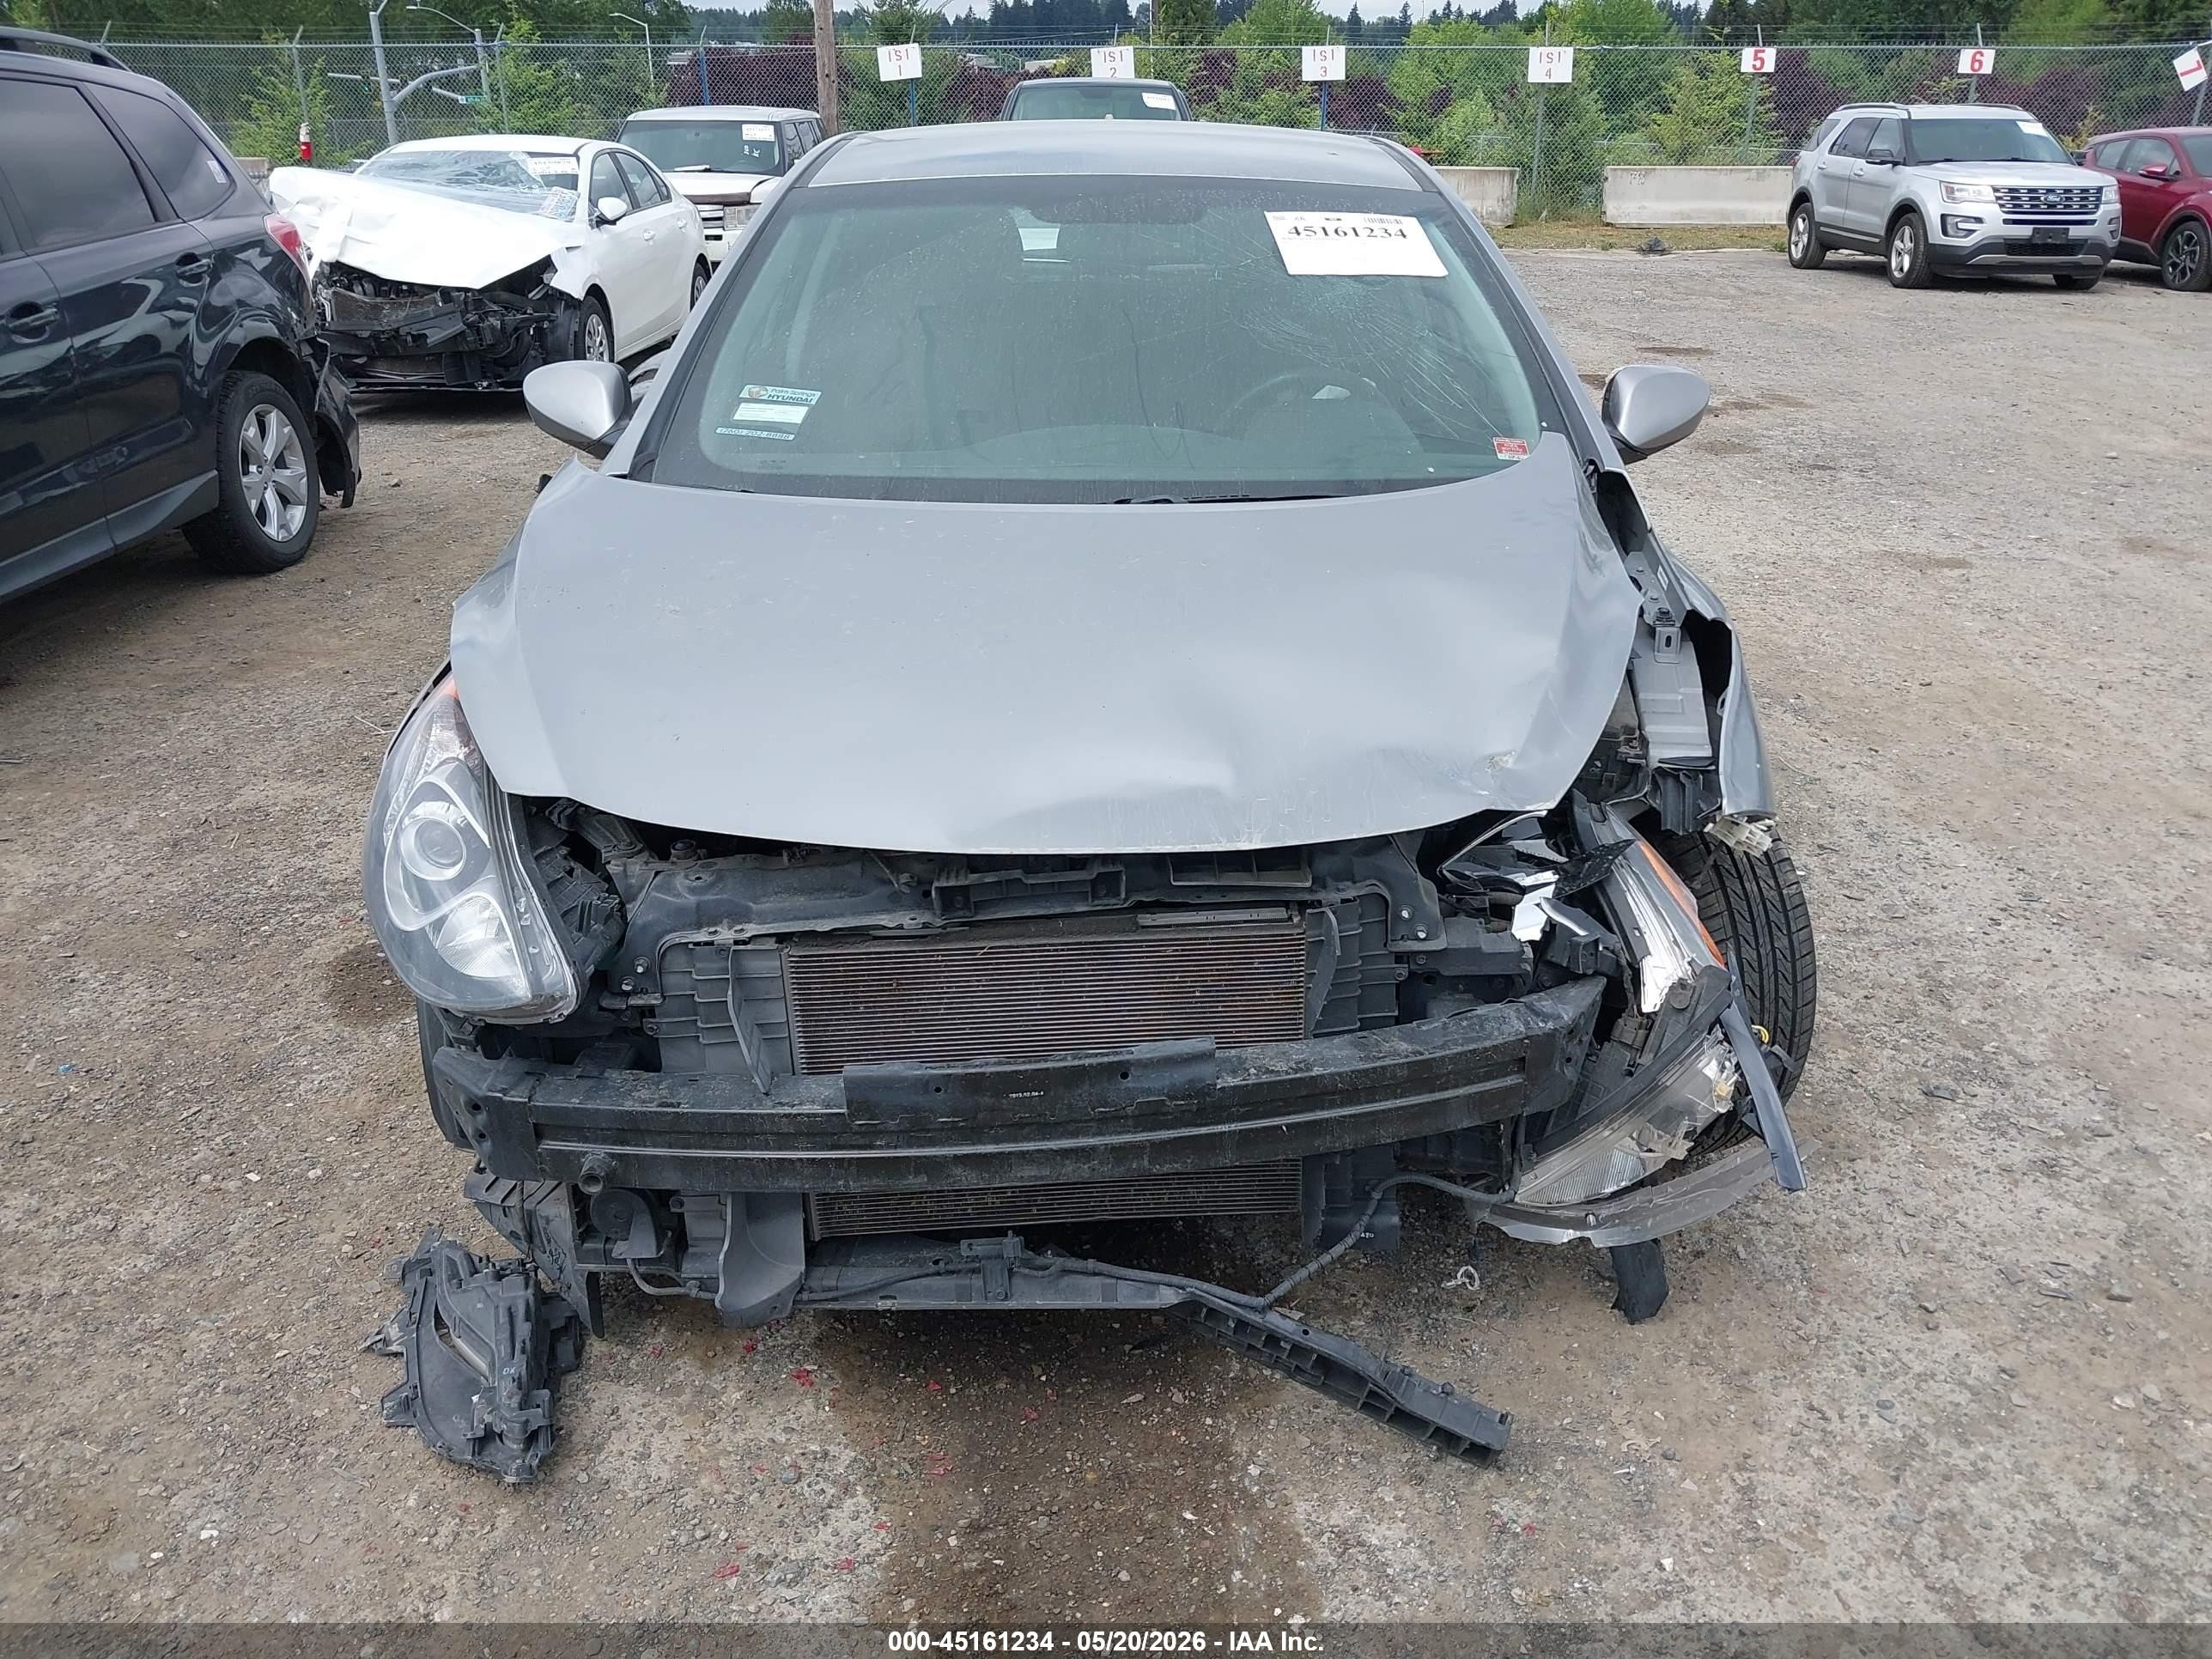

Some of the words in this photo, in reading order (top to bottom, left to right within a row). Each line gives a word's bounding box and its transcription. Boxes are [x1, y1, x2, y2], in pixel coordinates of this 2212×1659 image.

[1752, 48, 1765, 71] 5
[1970, 50, 1984, 72] 6
[1109, 67, 1117, 78] 2
[1320, 65, 1328, 77] 3
[1545, 67, 1553, 79] 4
[2179, 59, 2203, 77] 7
[1287, 225, 1408, 240] 45161234
[767, 393, 814, 404] HYUNDAI
